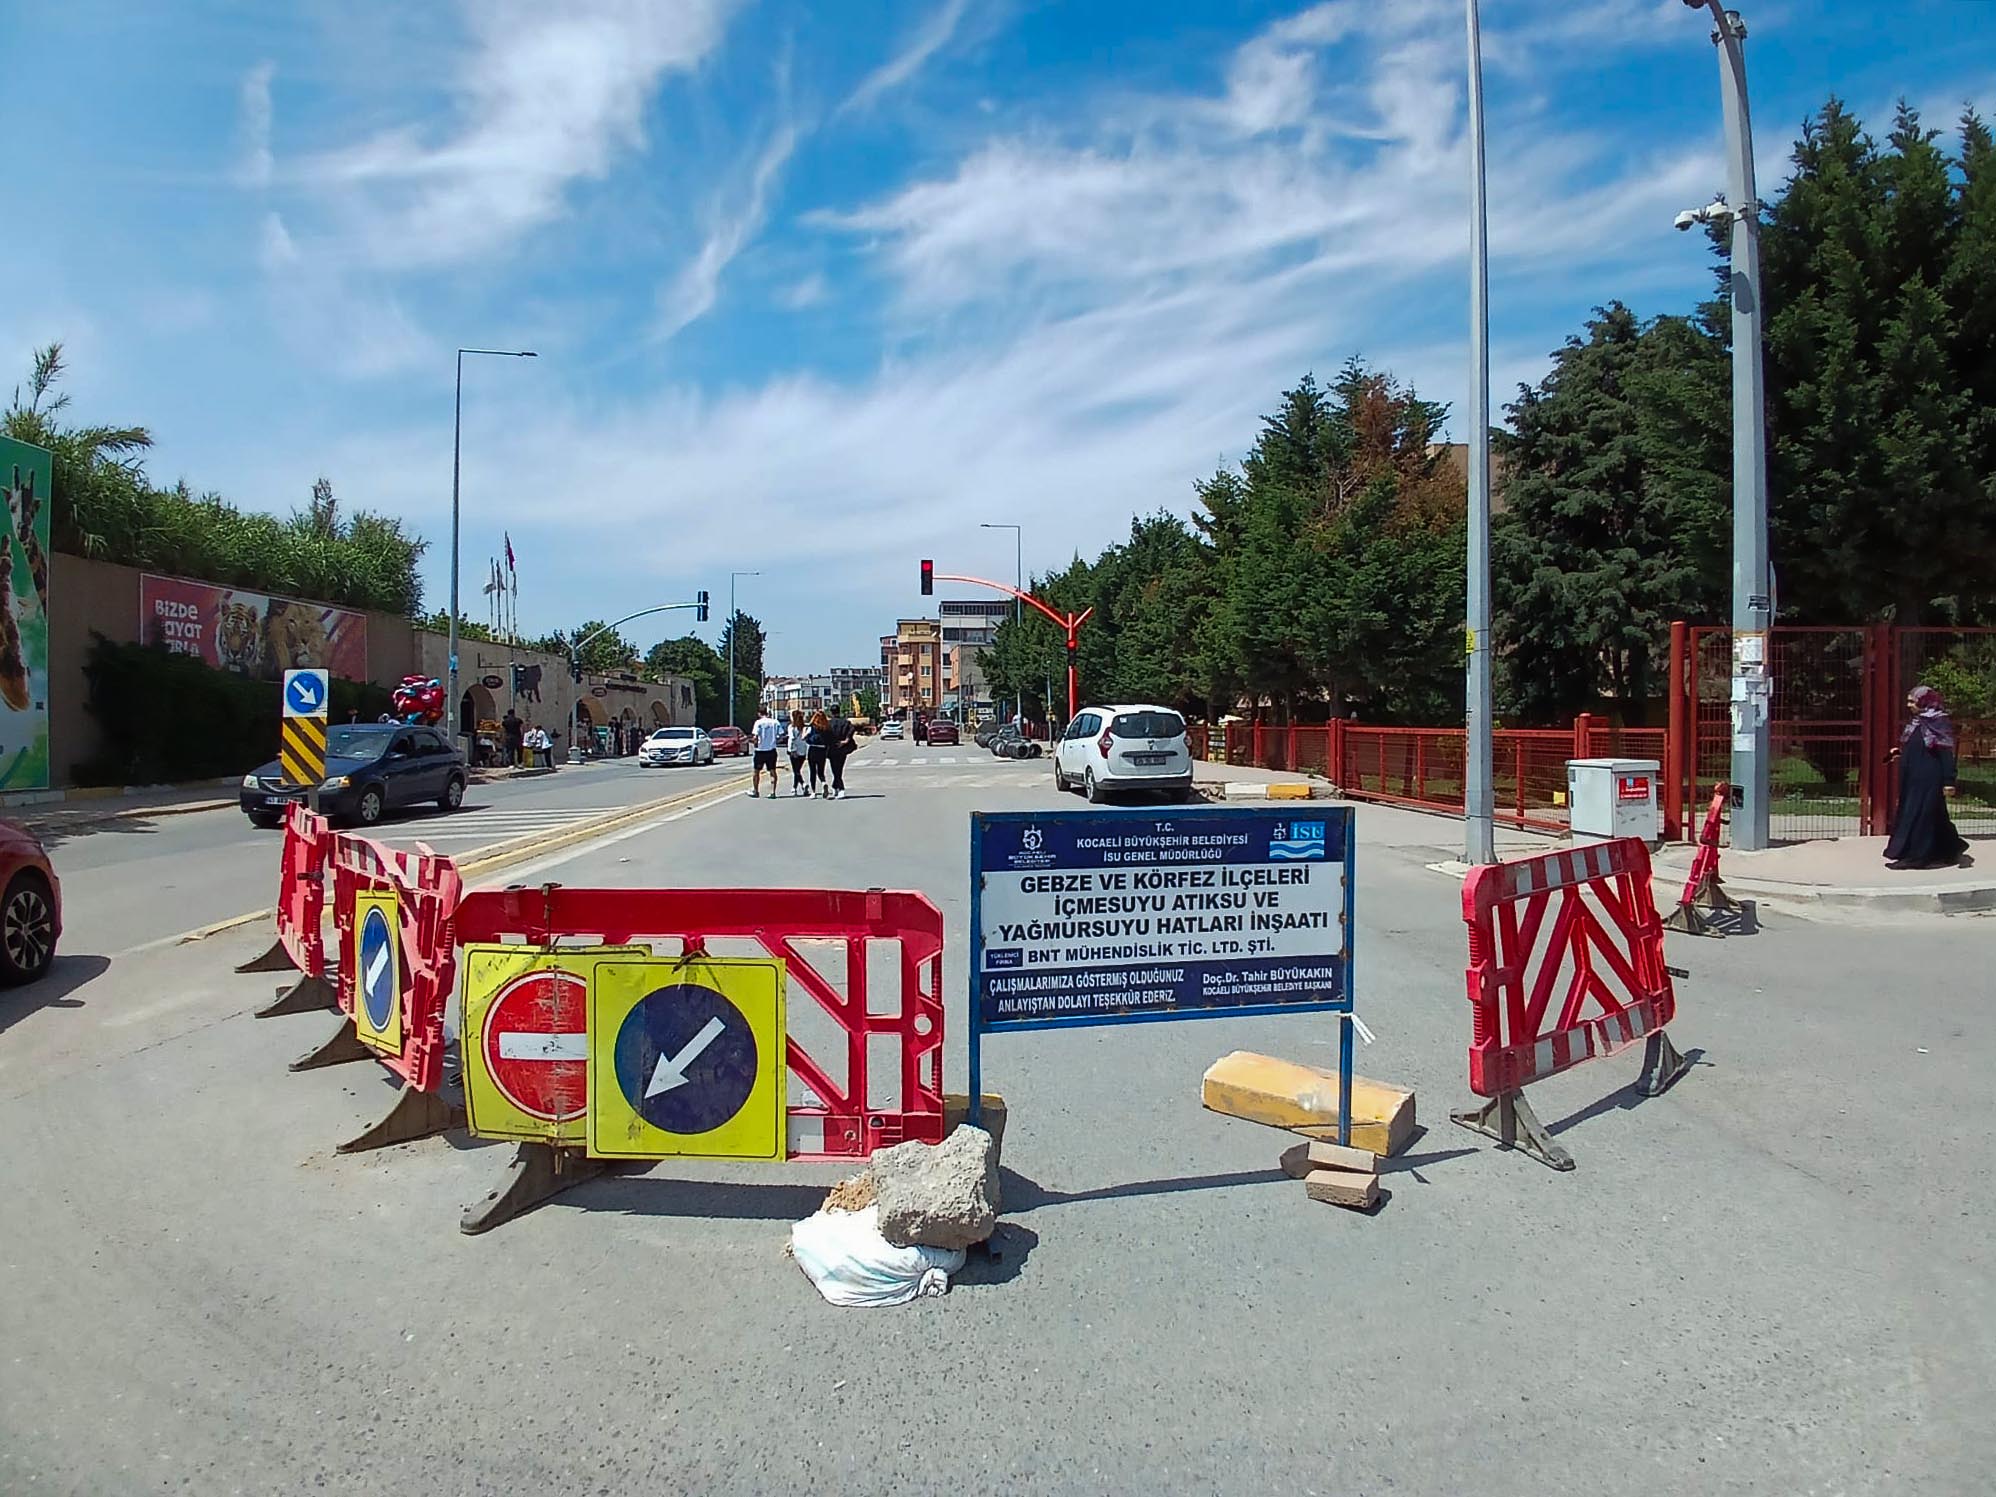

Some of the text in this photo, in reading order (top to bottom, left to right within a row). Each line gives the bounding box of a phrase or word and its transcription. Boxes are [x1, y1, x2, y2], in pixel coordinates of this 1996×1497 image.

[1155, 823, 1174, 832] T.C.
[1292, 826, 1324, 838] İSU
[1077, 833, 1248, 848] KOCAELİ BÜYÜKŞEHİR BELEDİYESİ
[1104, 849, 1222, 862] İSU GENEL MÜDÜRLÜĞÜ
[1021, 865, 1309, 893] GEBZE VE KÖRFEZ İLÇELERİ
[1054, 892, 1279, 919] İÇMESUYU ATIKSU VE
[999, 911, 1328, 942] YAĞMURSUYU HATLARI İNŞAATI
[1028, 937, 1275, 963] BNT MÜHENDİSLİK TİC. LTD. ŞTİ.
[989, 975, 1074, 995] ÇALIŞMALARIMIZA
[1129, 968, 1184, 985] OLDUĞUNUZ
[1203, 967, 1333, 986] Doç.Dr. Tahir BÜYÜKAKIN
[998, 995, 1056, 1013] ANLAYIŞTAN
[1057, 994, 1091, 1009] DOLAYI
[1093, 989, 1141, 1010] TEŞEKKÜR
